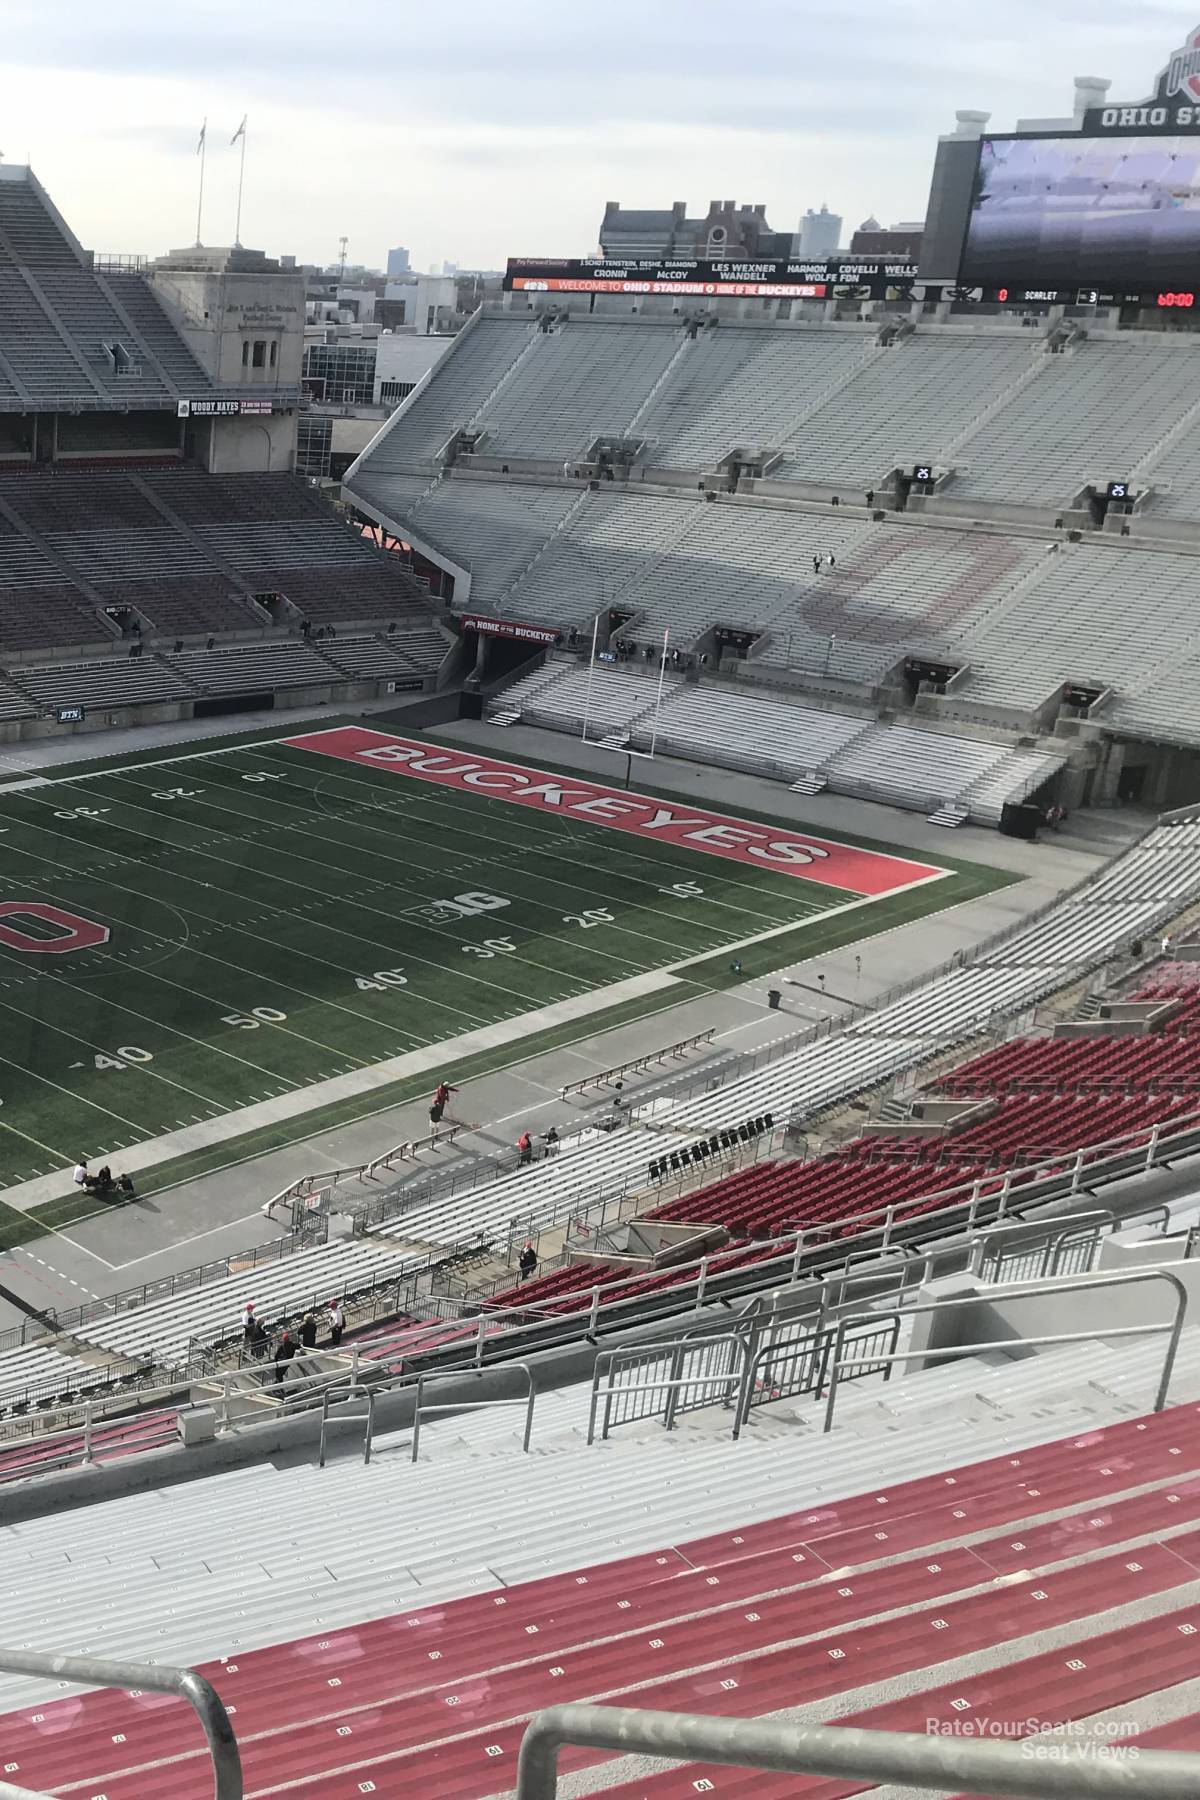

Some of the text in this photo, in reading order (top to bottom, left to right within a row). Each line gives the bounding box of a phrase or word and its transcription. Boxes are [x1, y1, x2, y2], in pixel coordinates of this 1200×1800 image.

[1102, 108, 1166, 126] OHIO
[712, 264, 776, 272] LES WEXNER
[788, 265, 827, 273] HARMON
[839, 265, 878, 274] COVELLI
[885, 265, 918, 274] WELLS
[594, 270, 628, 278] CRONIN
[657, 271, 688, 279] McCOY
[720, 272, 767, 280] WANDELL
[805, 273, 837, 282] WOLFE
[558, 281, 607, 290] WELCOME
[609, 282, 621, 290] TO
[623, 282, 650, 292] OHIO
[653, 283, 704, 293] STADIUM
[758, 285, 816, 296] BUCKEYES
[1024, 291, 1058, 301] SCARLET
[1089, 292, 1097, 302] 3
[191, 402, 216, 411] WOODY
[217, 402, 239, 411] HAYES
[917, 468, 929, 478] 25
[1111, 485, 1125, 496] 25
[476, 620, 500, 632] HOME
[515, 627, 556, 642] BUCKEYES
[241, 773, 280, 783] 10
[150, 787, 194, 800] 20
[354, 744, 829, 864] BUCKEYES
[54, 806, 101, 820] 30
[659, 881, 703, 899] 10
[563, 908, 614, 928] 20
[462, 938, 517, 958] 30
[354, 969, 407, 992] 40
[220, 1006, 288, 1030] 50
[93, 1046, 154, 1071] 40
[934, 1620, 946, 1629] 23
[1181, 1624, 1194, 1634] 23
[1069, 1659, 1083, 1670] 22
[723, 1680, 735, 1689] 21
[953, 1699, 968, 1710] 21
[339, 1727, 350, 1735] 19
[488, 1745, 500, 1756] 19
[361, 1781, 373, 1792] 18
[695, 1779, 711, 1791] 19
